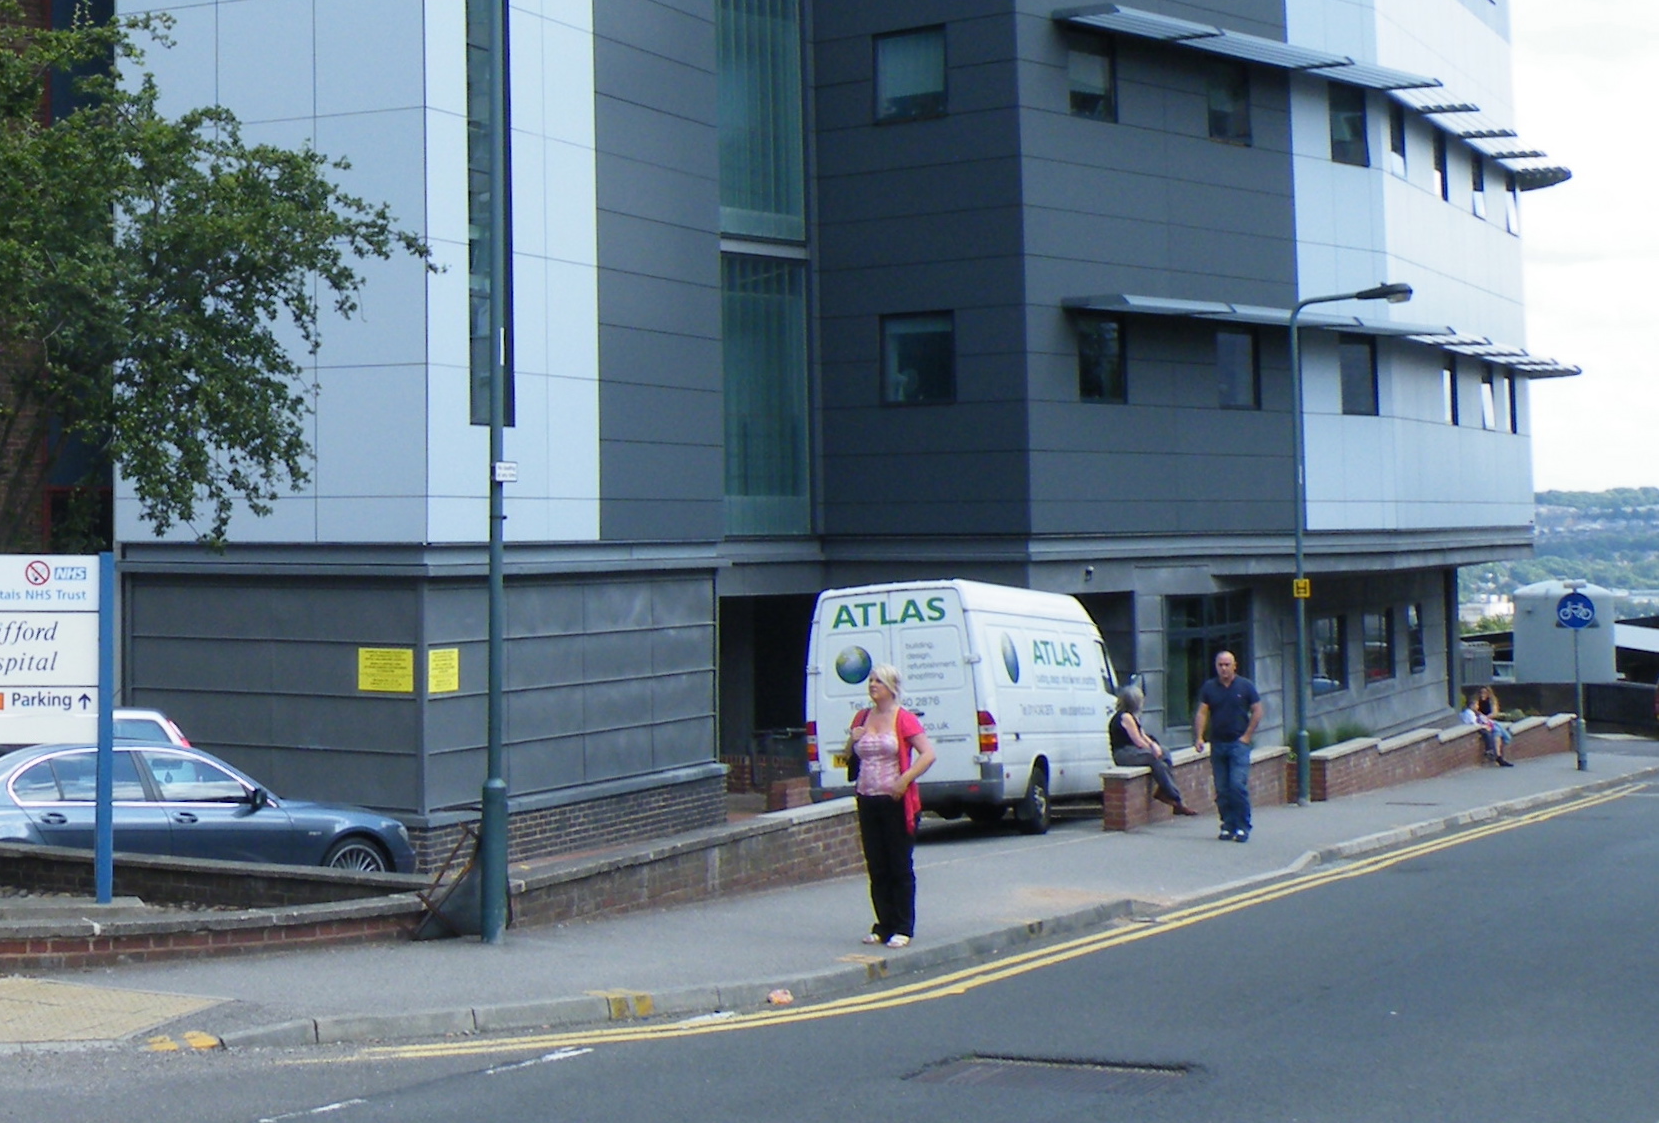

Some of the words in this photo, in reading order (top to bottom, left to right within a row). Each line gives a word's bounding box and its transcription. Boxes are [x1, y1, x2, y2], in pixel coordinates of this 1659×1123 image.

[56, 568, 86, 579] NHS
[25, 590, 52, 601] NHS
[55, 590, 87, 601] Trust
[832, 597, 946, 629] ATLAS
[1033, 639, 1081, 667] ATLAS
[11, 692, 73, 711] Parking
[916, 696, 940, 706] 2876
